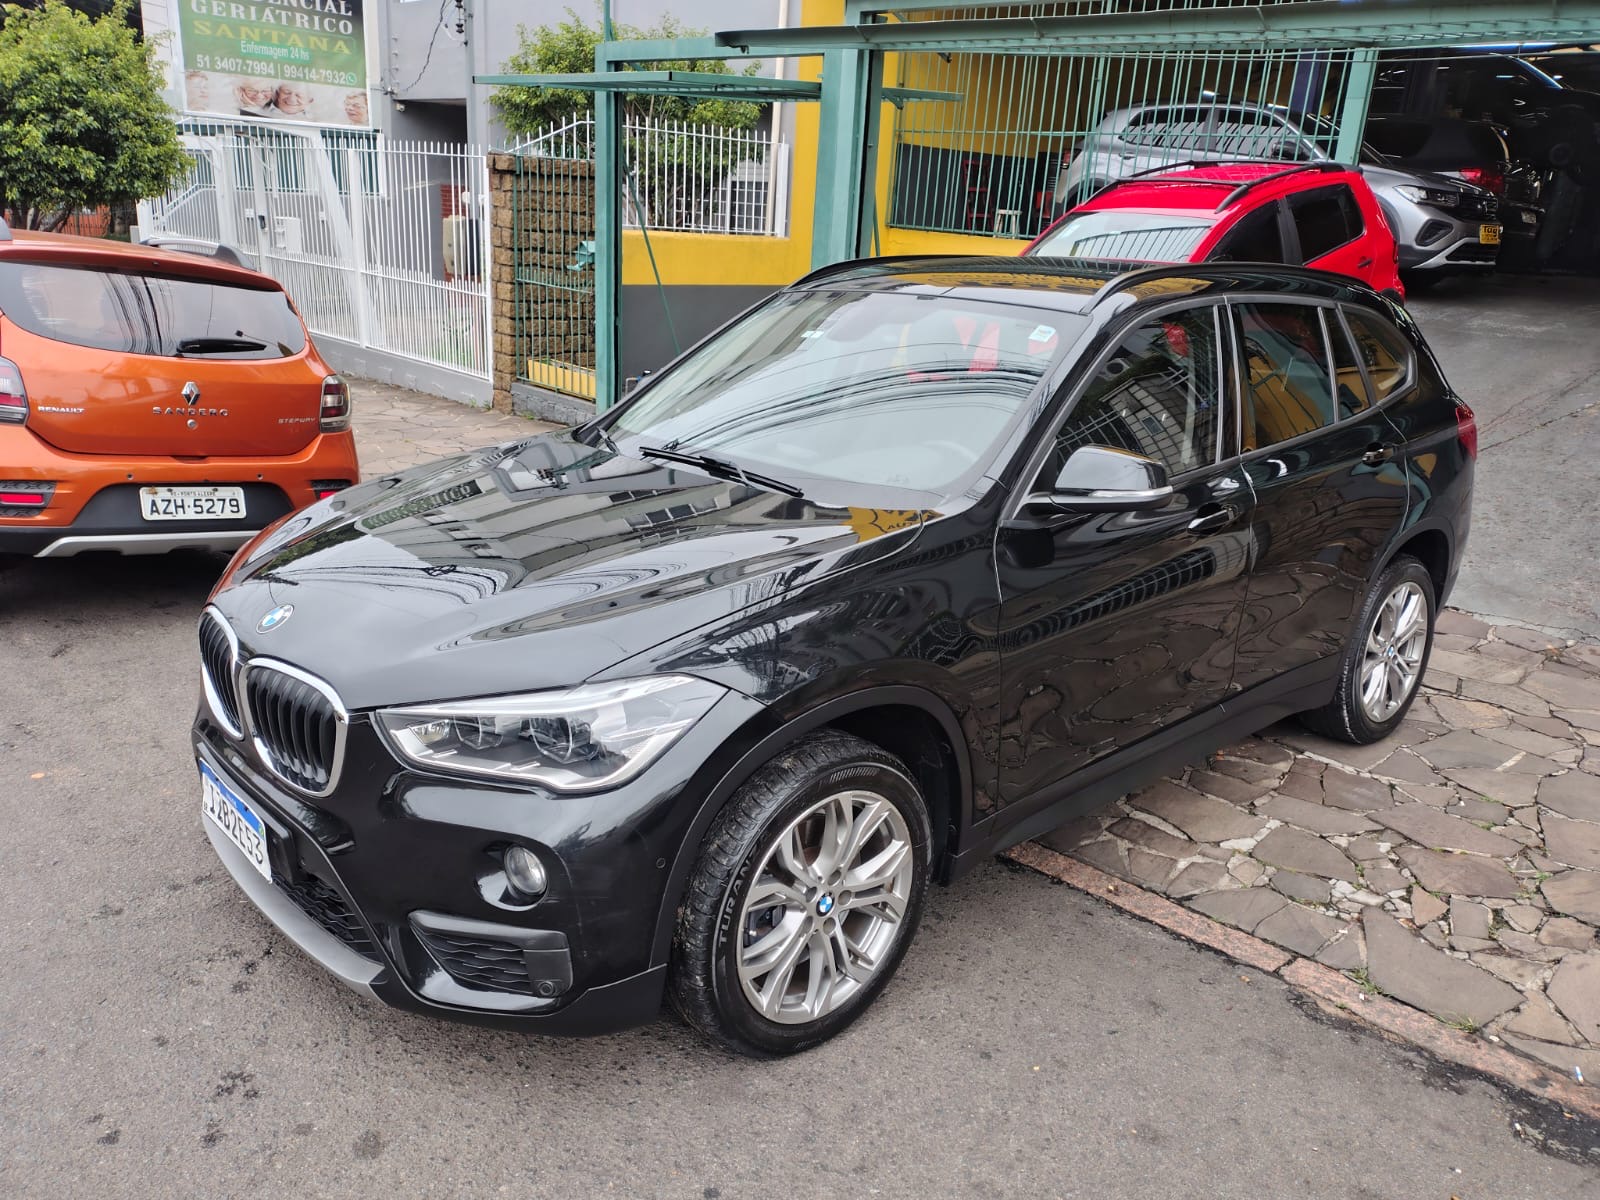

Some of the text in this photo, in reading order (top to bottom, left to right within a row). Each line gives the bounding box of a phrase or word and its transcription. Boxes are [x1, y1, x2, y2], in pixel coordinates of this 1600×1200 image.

[192, 19, 352, 55] SANTANA
[240, 39, 288, 59] Enfermagem
[290, 46, 299, 59] 24
[196, 54, 346, 84] 51 3407-7994 99414-7932
[37, 405, 86, 413] RENAULT
[152, 406, 229, 417] SANDERO
